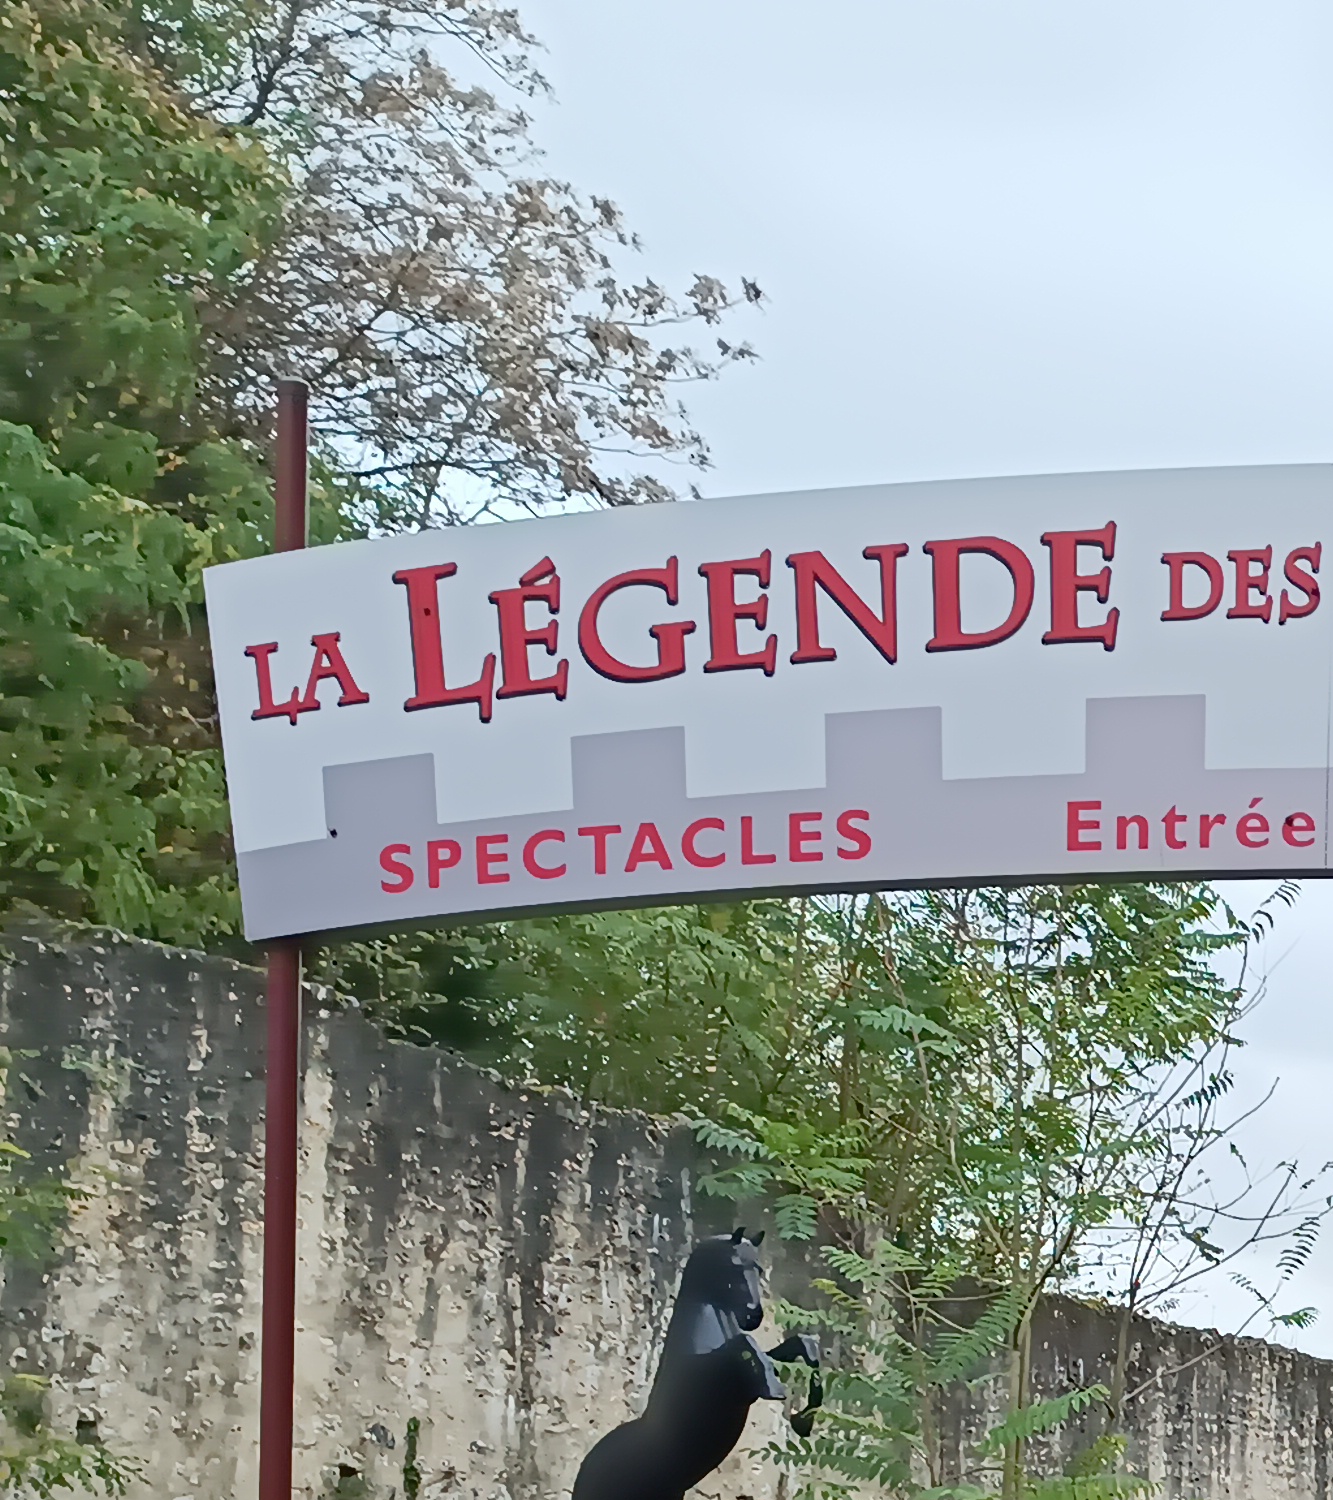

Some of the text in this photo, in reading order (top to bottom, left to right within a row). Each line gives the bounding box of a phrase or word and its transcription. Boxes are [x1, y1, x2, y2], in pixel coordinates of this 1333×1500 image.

[244, 631, 371, 727] LA
[391, 520, 1122, 725] LÉGENDE
[1159, 541, 1324, 626] DES
[379, 809, 873, 895] SPECTACLES
[1066, 797, 1316, 853] Entrée
